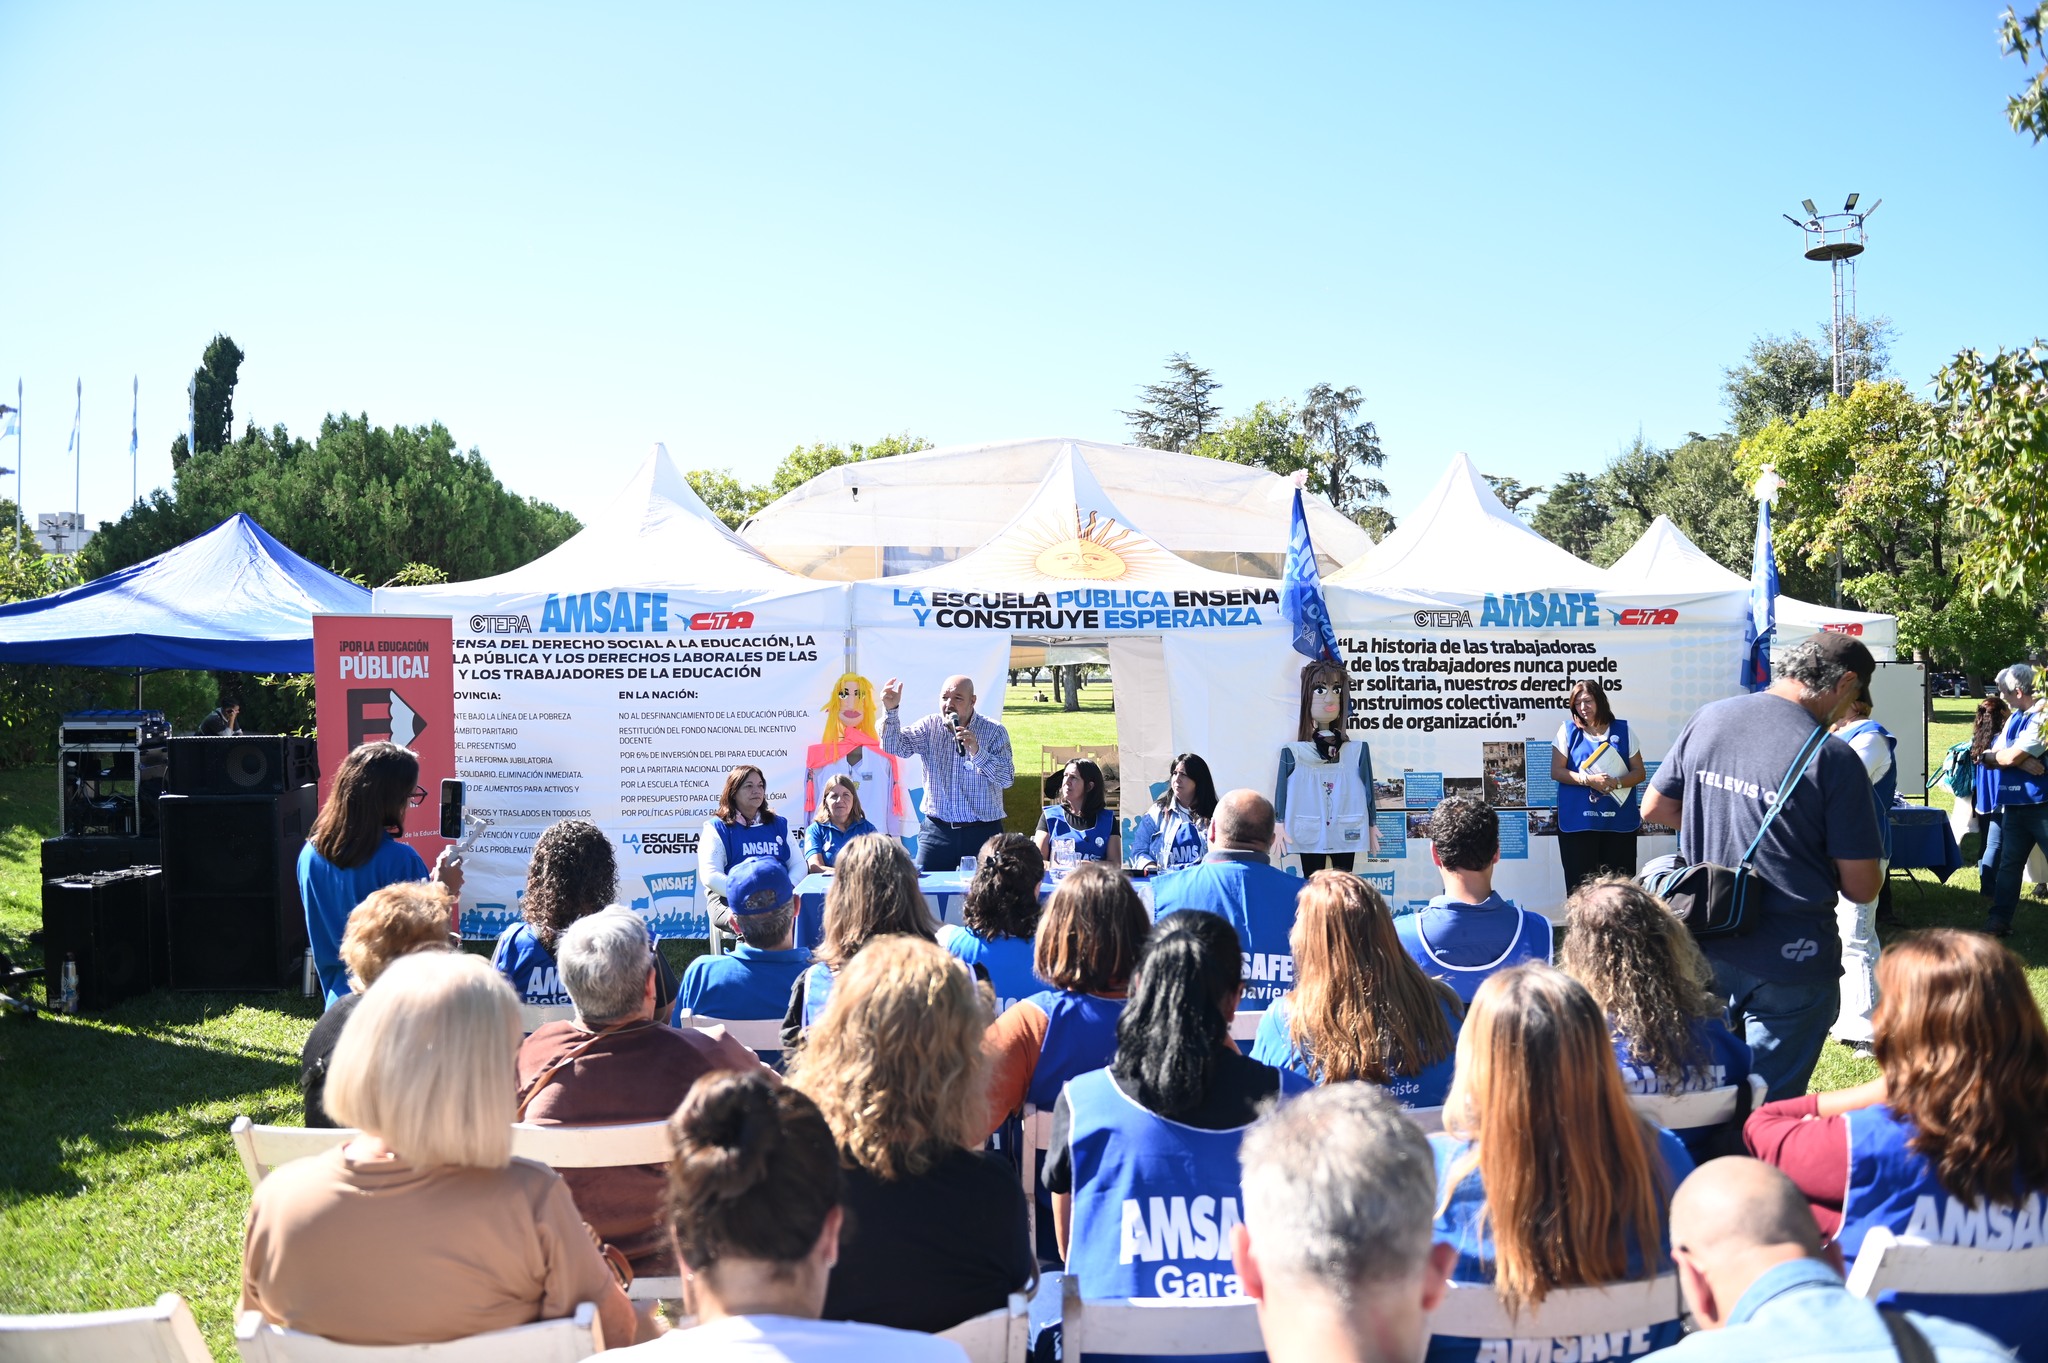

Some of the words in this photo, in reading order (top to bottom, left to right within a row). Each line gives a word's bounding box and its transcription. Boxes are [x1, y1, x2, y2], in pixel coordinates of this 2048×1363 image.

[893, 589, 926, 607] LA
[932, 591, 1051, 609] ESCUELA
[470, 614, 532, 634] CTERA
[539, 591, 668, 634] AMSAFE
[1413, 610, 1473, 628] CTERA
[1480, 592, 1599, 628] AMSAFE
[913, 609, 931, 627] Y
[936, 609, 1098, 629] CONSTRUYE
[1104, 607, 1262, 629] ESPERANZA
[339, 640, 363, 653] ¡POR
[364, 640, 375, 652] LA
[378, 638, 429, 653] EDUCACIÓN
[501, 640, 529, 649] DEL
[532, 640, 605, 650] DERECHO
[608, 638, 664, 649] SOCIAL
[666, 639, 677, 649] A
[679, 639, 698, 649] LA
[701, 634, 794, 649] EDUCACIÓN,
[797, 635, 816, 646] LA
[1371, 637, 1437, 654] historia
[1440, 639, 1461, 654] de
[1463, 639, 1488, 655] las
[1490, 639, 1597, 657] trabajadoras
[474, 650, 539, 664] PÚBLICA
[542, 653, 552, 664] Y
[555, 653, 584, 664] LOS
[588, 653, 670, 663] DERECHOS
[674, 651, 763, 663] LABORALES
[766, 651, 785, 662] DE
[789, 651, 818, 662] LAS
[339, 651, 430, 679] PÚBLICA!
[1350, 656, 1372, 672] de
[1375, 656, 1399, 672] los
[1402, 657, 1511, 675] trabajadores
[1514, 660, 1564, 673] nunca
[1567, 658, 1617, 677] puede
[458, 669, 468, 680] Y
[471, 669, 501, 680] LOS
[504, 668, 624, 680] TRABAJADORES
[627, 668, 647, 679] DE
[650, 668, 669, 679] LA
[672, 665, 761, 679] EDUCACIÓN
[1367, 675, 1441, 693] solitaria,
[1444, 676, 1518, 692] nuestros
[1521, 675, 1582, 692] derech
[618, 691, 634, 700] EN
[635, 691, 650, 699] LA
[651, 688, 699, 699] NACIÓN:
[1445, 693, 1570, 711] colectivamente
[468, 712, 486, 720] BAJO
[486, 712, 495, 720] LA
[497, 711, 517, 720] LÍNEA
[518, 712, 527, 720] DE
[529, 712, 538, 720] LA
[539, 712, 572, 720] POBREZA
[618, 712, 629, 720] NO
[641, 711, 714, 719] DESFINANCIAMIENTO
[716, 711, 725, 719] DE
[736, 710, 777, 718] EDUCACIÓN
[778, 709, 809, 718] PÚBLICA.
[1382, 713, 1403, 730] de
[1406, 712, 1526, 732] organización.”
[482, 727, 518, 735] PARITARIO
[618, 725, 666, 735] RESTITUCIÓN
[666, 726, 680, 734] DEL
[681, 726, 706, 734] FONDO
[707, 726, 743, 734] NACIONAL
[744, 725, 757, 733] DEL
[758, 725, 796, 733] INCENTIVO
[467, 742, 517, 750] PRESENTISMO
[619, 737, 652, 745] DOCENTE
[475, 756, 508, 764] REFORMA
[620, 751, 635, 759] POR
[636, 751, 649, 759] 6%
[650, 751, 660, 759] DE
[660, 750, 699, 759] INVERSIÓN
[727, 750, 746, 758] PARA
[747, 749, 788, 758] EDUCACIÓN
[460, 770, 498, 778] SOLIDARIO.
[498, 769, 544, 779] ELIMINACIÓN
[544, 771, 584, 779] INMEDIATA.
[620, 766, 636, 774] POR
[637, 766, 646, 774] LA
[647, 765, 684, 773] PARITARIA
[684, 765, 720, 773] NACIONAL
[473, 784, 482, 792] DE
[484, 785, 523, 793] AUMENTOS
[524, 785, 543, 793] PARA
[544, 785, 570, 793] ACTIVOS
[572, 785, 580, 793] Y
[647, 780, 678, 788] ESCUELA
[680, 779, 709, 788] TÉCNICA
[620, 795, 636, 803] POR
[637, 795, 688, 803] PRESUPUESTO
[689, 794, 709, 802] PARA
[493, 809, 498, 817] Y
[499, 809, 540, 817] TRASLADOS
[541, 809, 551, 817] EN
[552, 809, 576, 817] TODOS
[578, 809, 592, 817] LOS
[621, 809, 637, 817] POR
[638, 808, 674, 817] POLÍTICAS
[674, 807, 708, 816] PÚBLICAS
[622, 834, 639, 844] LA
[641, 833, 700, 844] ESCUELA
[632, 844, 641, 854] Y
[643, 843, 699, 854] CONSTR
[742, 842, 780, 856] AMSAFE
[650, 875, 696, 893] AMSAFE
[1904, 1191, 2048, 1253] AMSA
